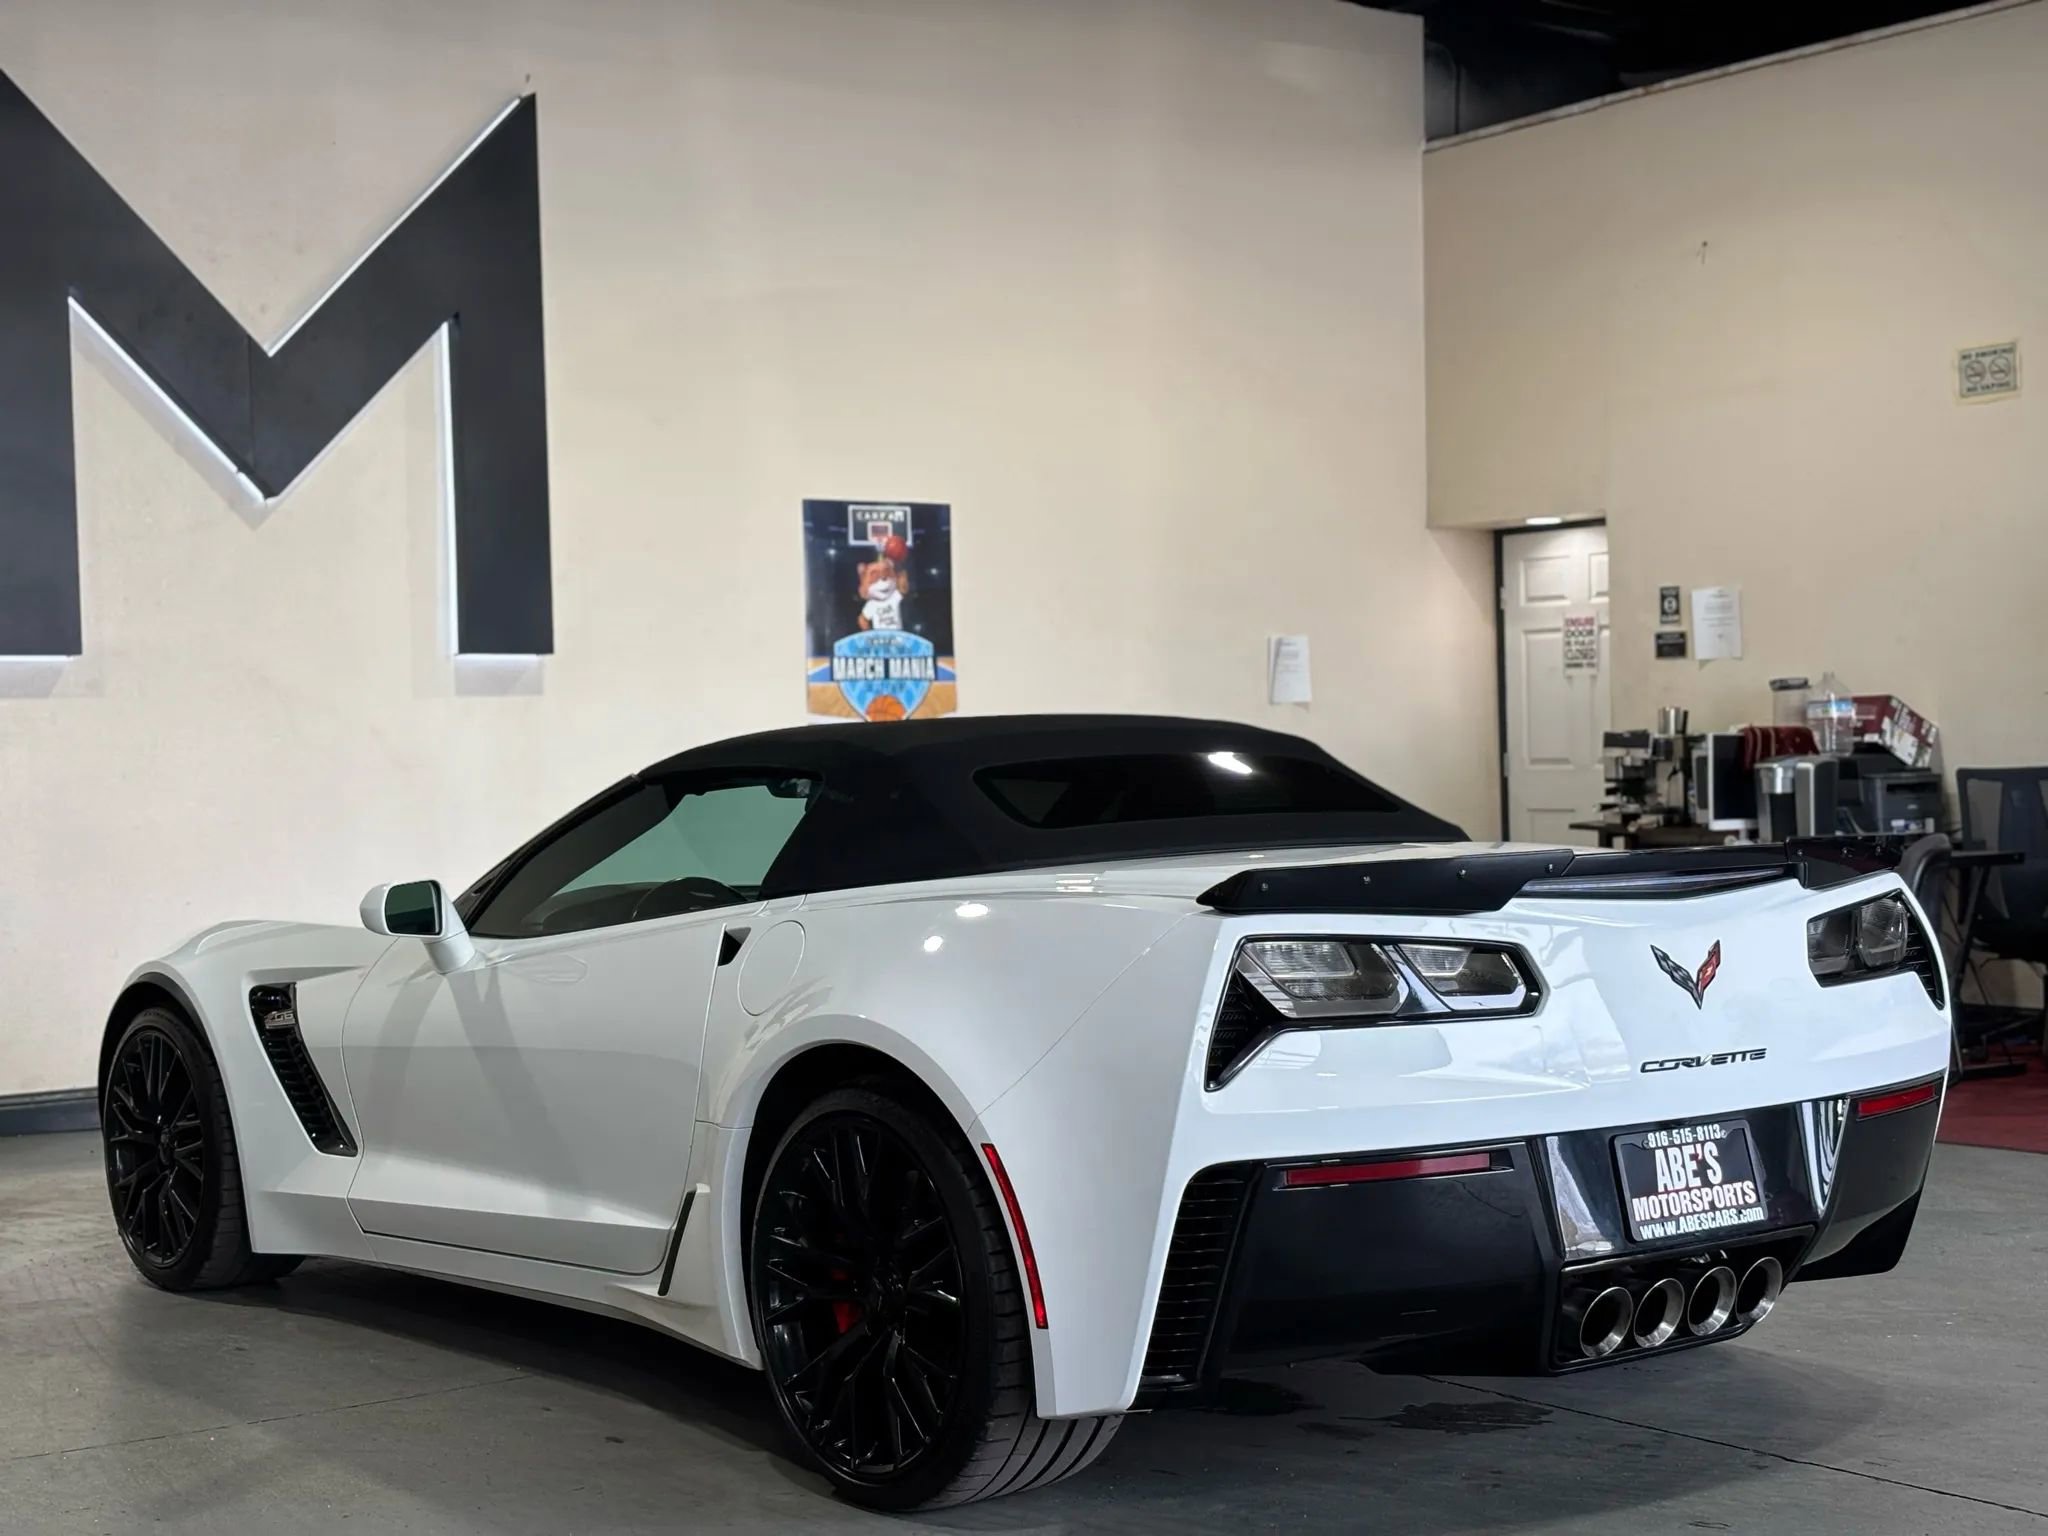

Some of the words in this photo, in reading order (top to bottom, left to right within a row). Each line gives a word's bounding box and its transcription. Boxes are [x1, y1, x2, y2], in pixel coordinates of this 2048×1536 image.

[0, 66, 554, 655] M
[833, 656, 885, 680] MARCH
[889, 657, 936, 680] MANIA
[1640, 1047, 1768, 1073] CORVETTE
[1647, 1123, 1721, 1148] 916-515-8113
[1654, 1141, 1722, 1193] ABE'S
[1631, 1180, 1757, 1222] MOTORSPORTS
